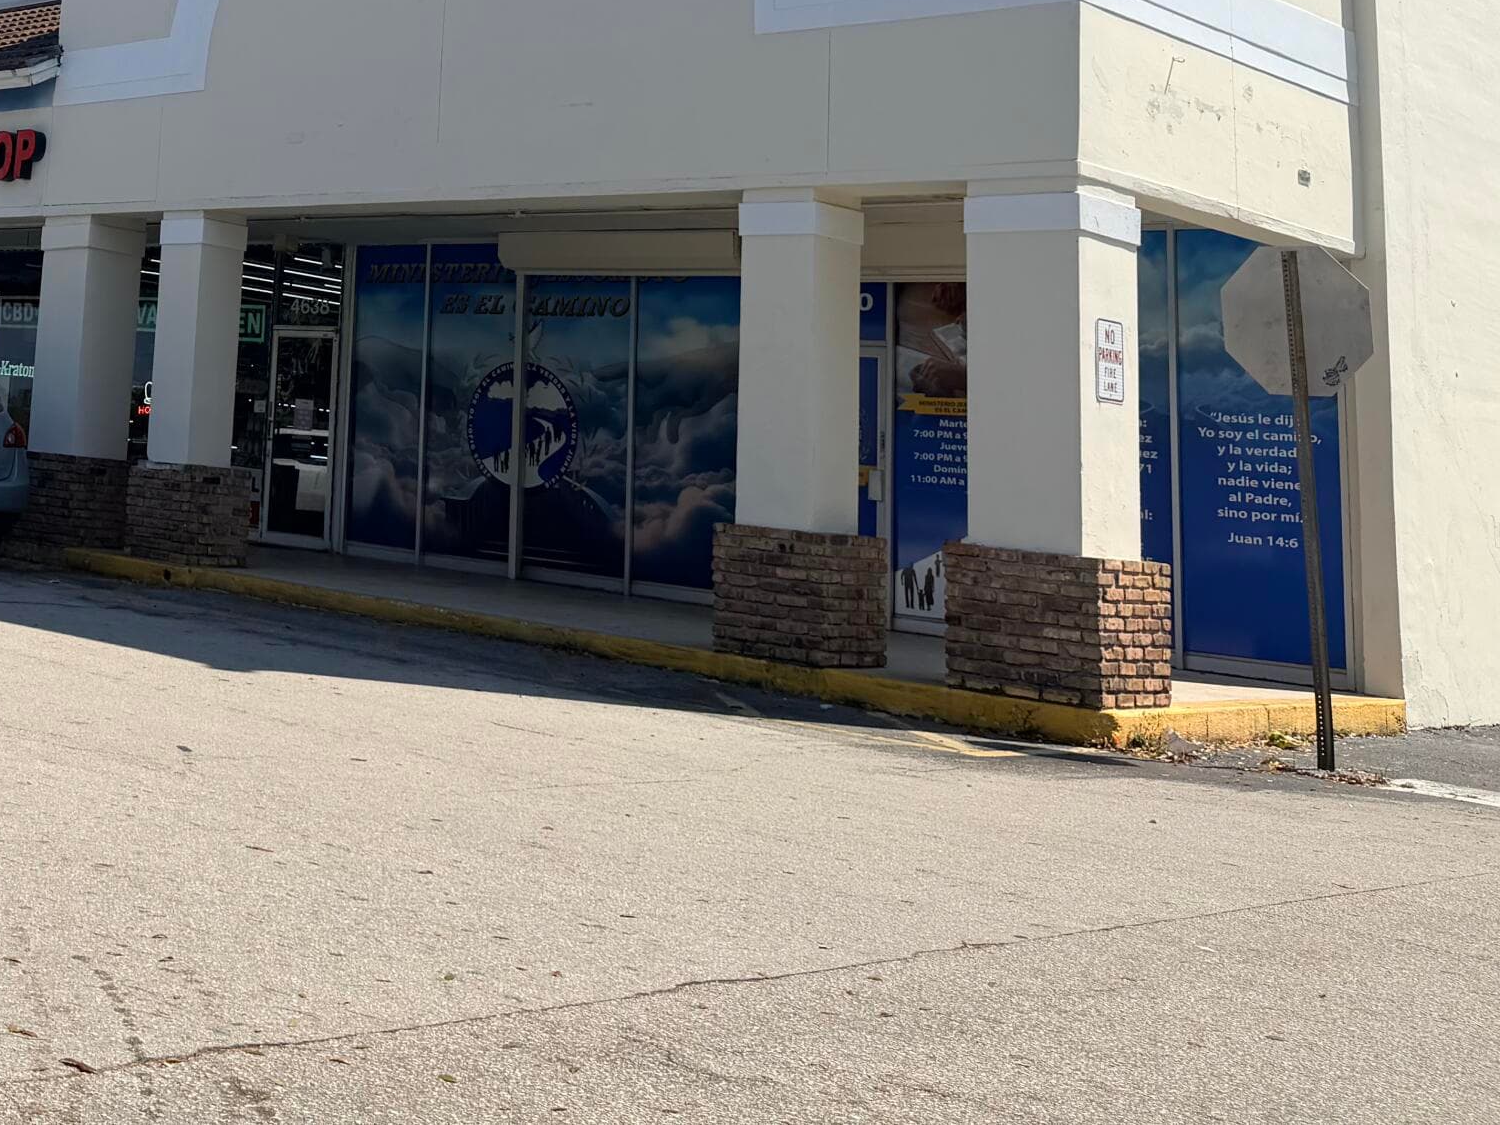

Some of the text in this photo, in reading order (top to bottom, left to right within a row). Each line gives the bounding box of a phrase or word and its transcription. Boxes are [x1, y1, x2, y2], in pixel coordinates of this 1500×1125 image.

[2, 301, 34, 323] CBD
[290, 297, 331, 316] 4638
[439, 293, 632, 318] ES EL AMINO
[1104, 327, 1116, 345] NO
[1098, 347, 1122, 366] PARKING
[1104, 367, 1117, 379] FIRE
[1103, 381, 1118, 393] LANE
[1258, 413, 1272, 425] le
[1274, 414, 1300, 428] dij
[913, 429, 935, 438] 7:00
[937, 430, 953, 439] PM
[955, 432, 962, 440] a
[1198, 426, 1322, 445] Yo soy el camio,
[913, 452, 935, 461] 7:00
[937, 453, 953, 462] PM
[955, 455, 962, 463] a
[1217, 443, 1298, 458] y la verdad
[1227, 460, 1293, 475] y la vida;
[910, 474, 965, 486] 11:00 AM a
[1218, 475, 1259, 488] nadie
[1228, 491, 1292, 507] al Padre,
[1217, 506, 1248, 519] sino
[1251, 510, 1277, 522] por
[1227, 532, 1299, 549] Juan 14:6
